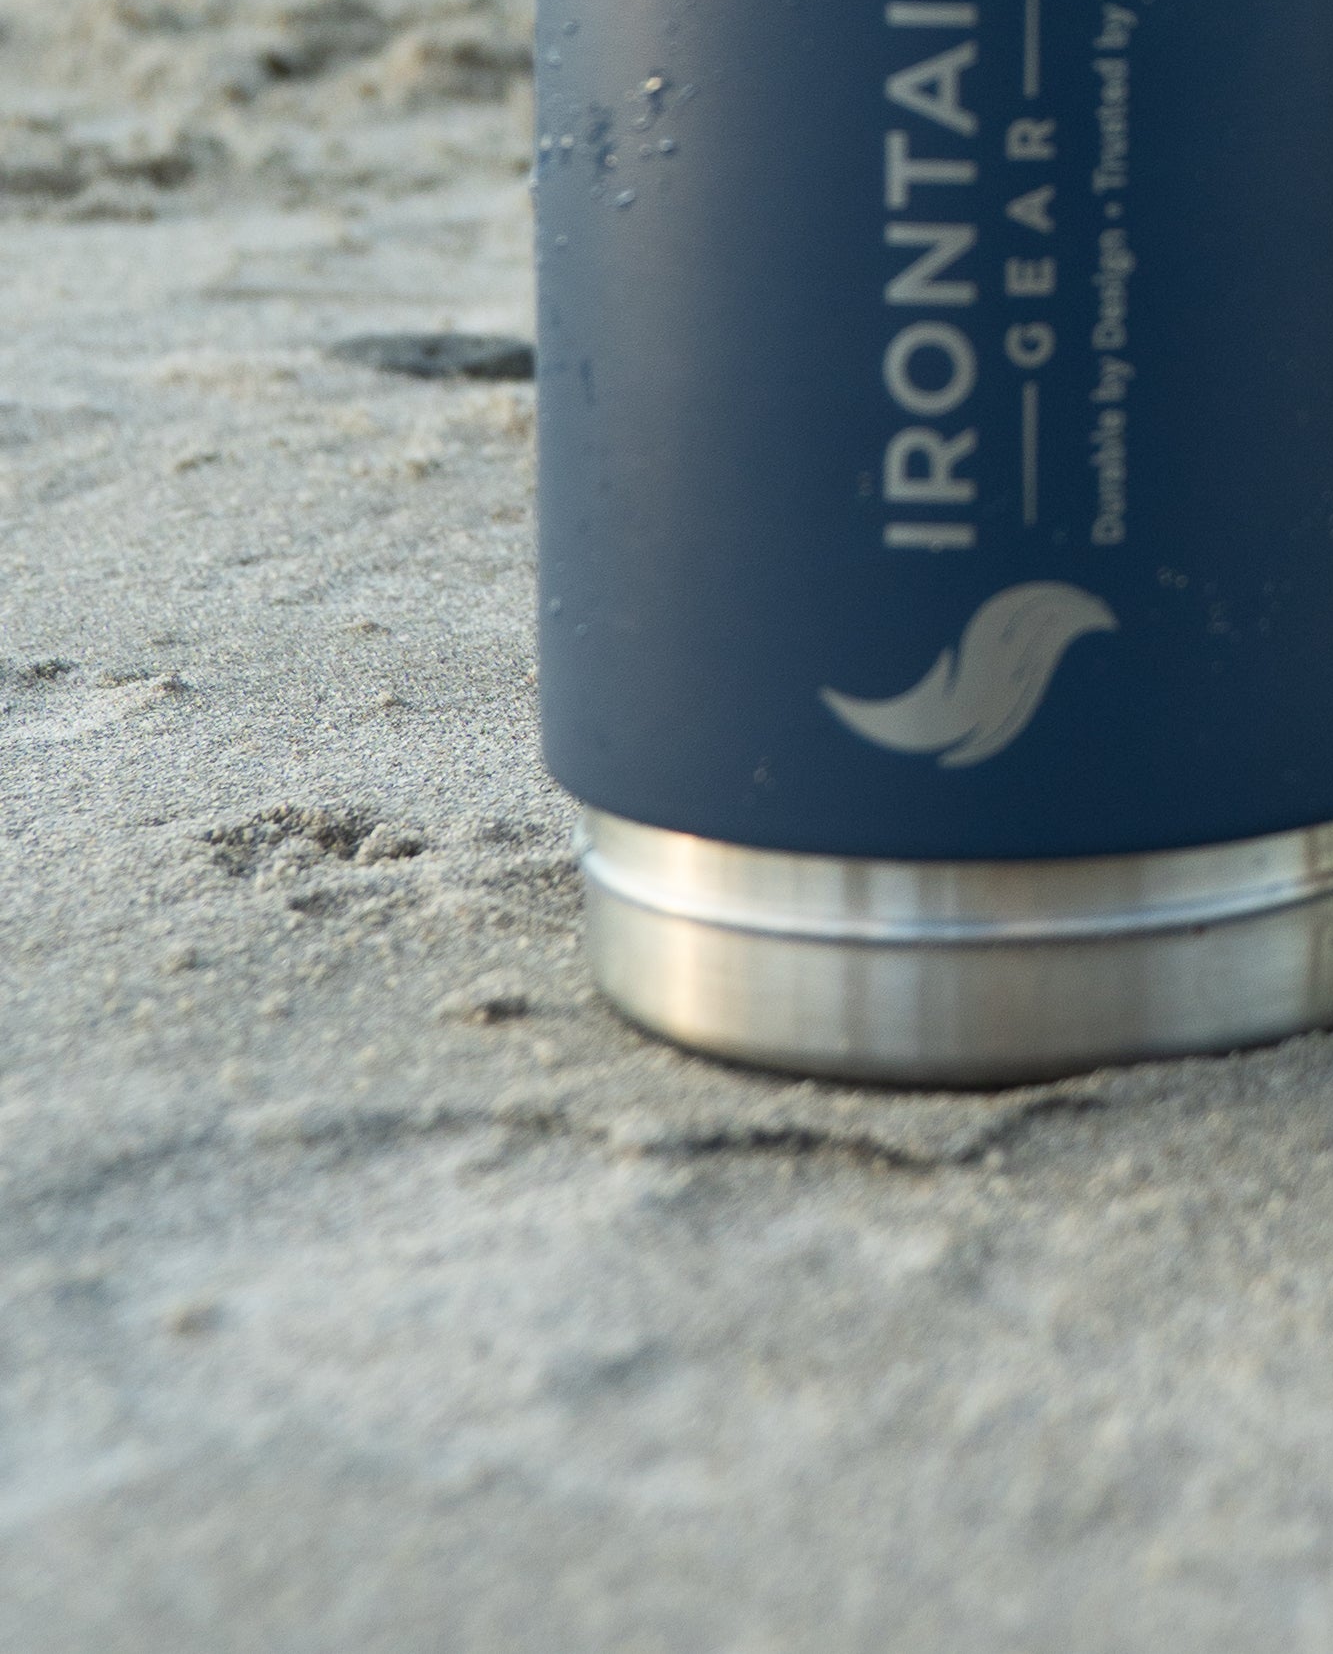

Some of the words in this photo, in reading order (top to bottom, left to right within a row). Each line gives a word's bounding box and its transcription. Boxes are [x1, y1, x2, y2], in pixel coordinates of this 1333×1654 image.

[1094, 4, 1137, 48] by
[1093, 58, 1128, 192] Trusted
[1005, 118, 1055, 369] GEAR
[1092, 228, 1135, 350] Design
[1090, 356, 1135, 402] by
[1091, 409, 1127, 545] Durable
